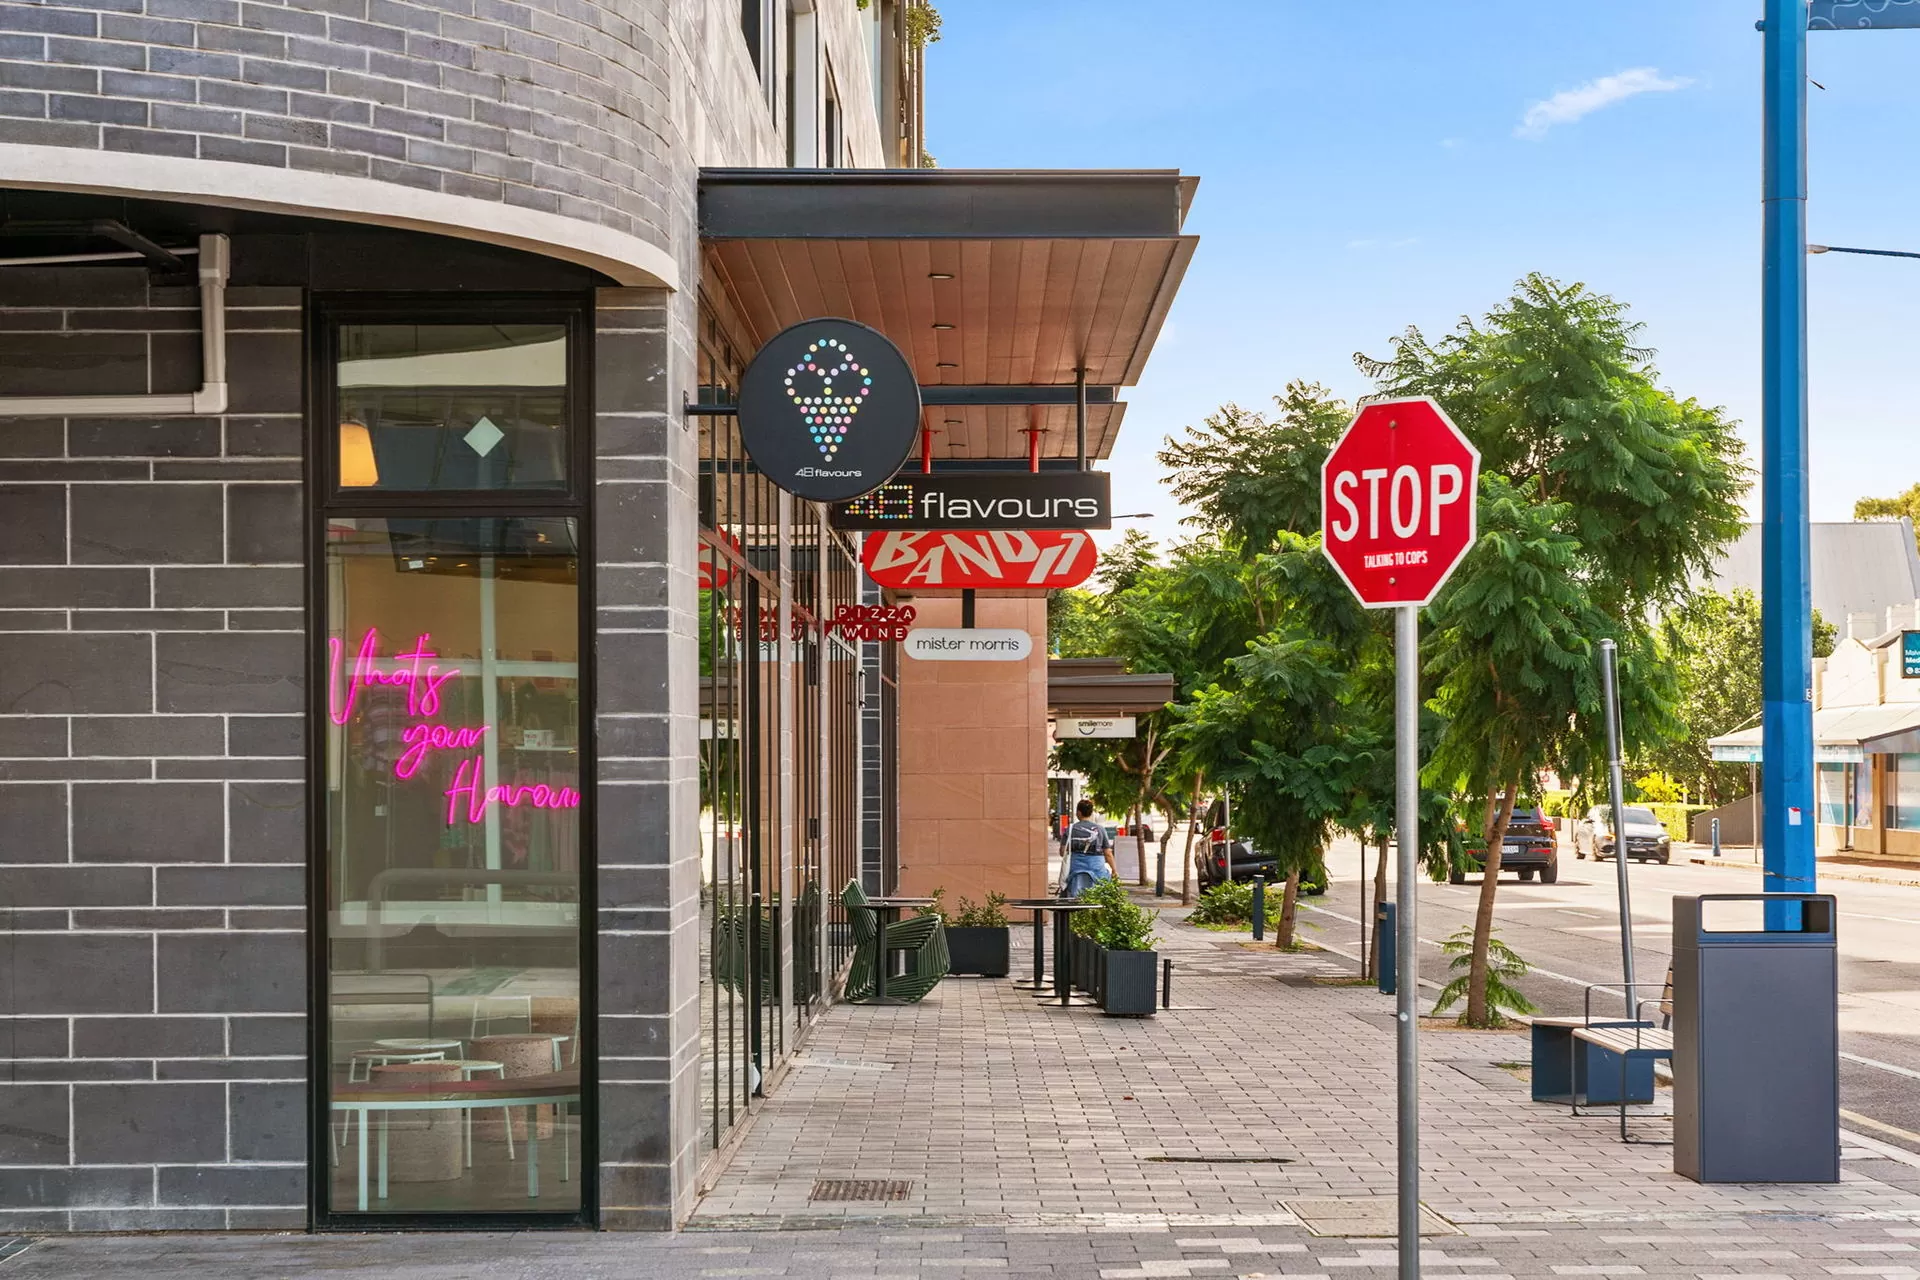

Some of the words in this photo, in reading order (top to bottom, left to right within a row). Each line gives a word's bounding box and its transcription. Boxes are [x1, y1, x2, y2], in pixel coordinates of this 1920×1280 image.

[795, 467, 814, 477] 48
[815, 469, 862, 477] flavours
[920, 492, 1099, 519] flavours
[1332, 464, 1463, 542] STOP
[1364, 553, 1394, 568] TALKING
[1395, 551, 1405, 566] TO
[1405, 550, 1429, 564] COPS
[838, 607, 913, 620] PIZZA
[844, 627, 904, 640] WINE
[917, 637, 965, 650] mister
[970, 637, 1019, 650] morris
[396, 724, 491, 778] your
